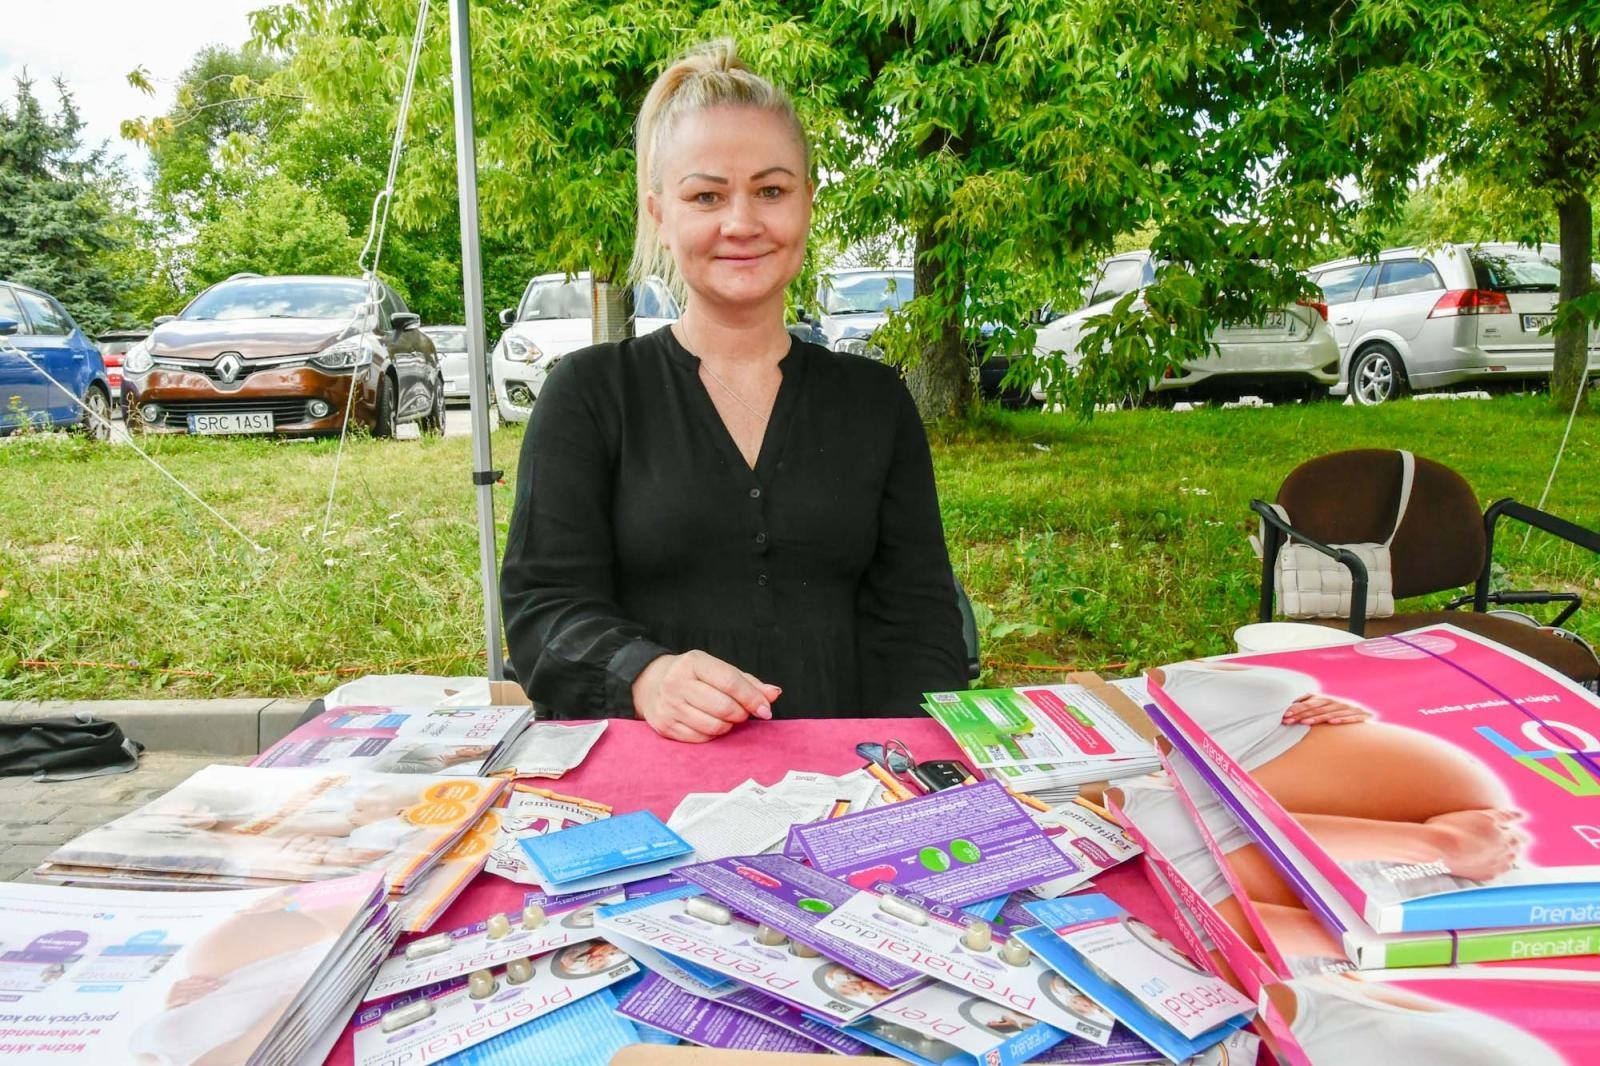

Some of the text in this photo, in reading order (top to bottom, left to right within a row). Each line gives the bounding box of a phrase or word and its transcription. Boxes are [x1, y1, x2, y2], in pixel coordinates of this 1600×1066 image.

[198, 415, 270, 430] SRC 1AS1
[1510, 936, 1592, 958] Prenatal
